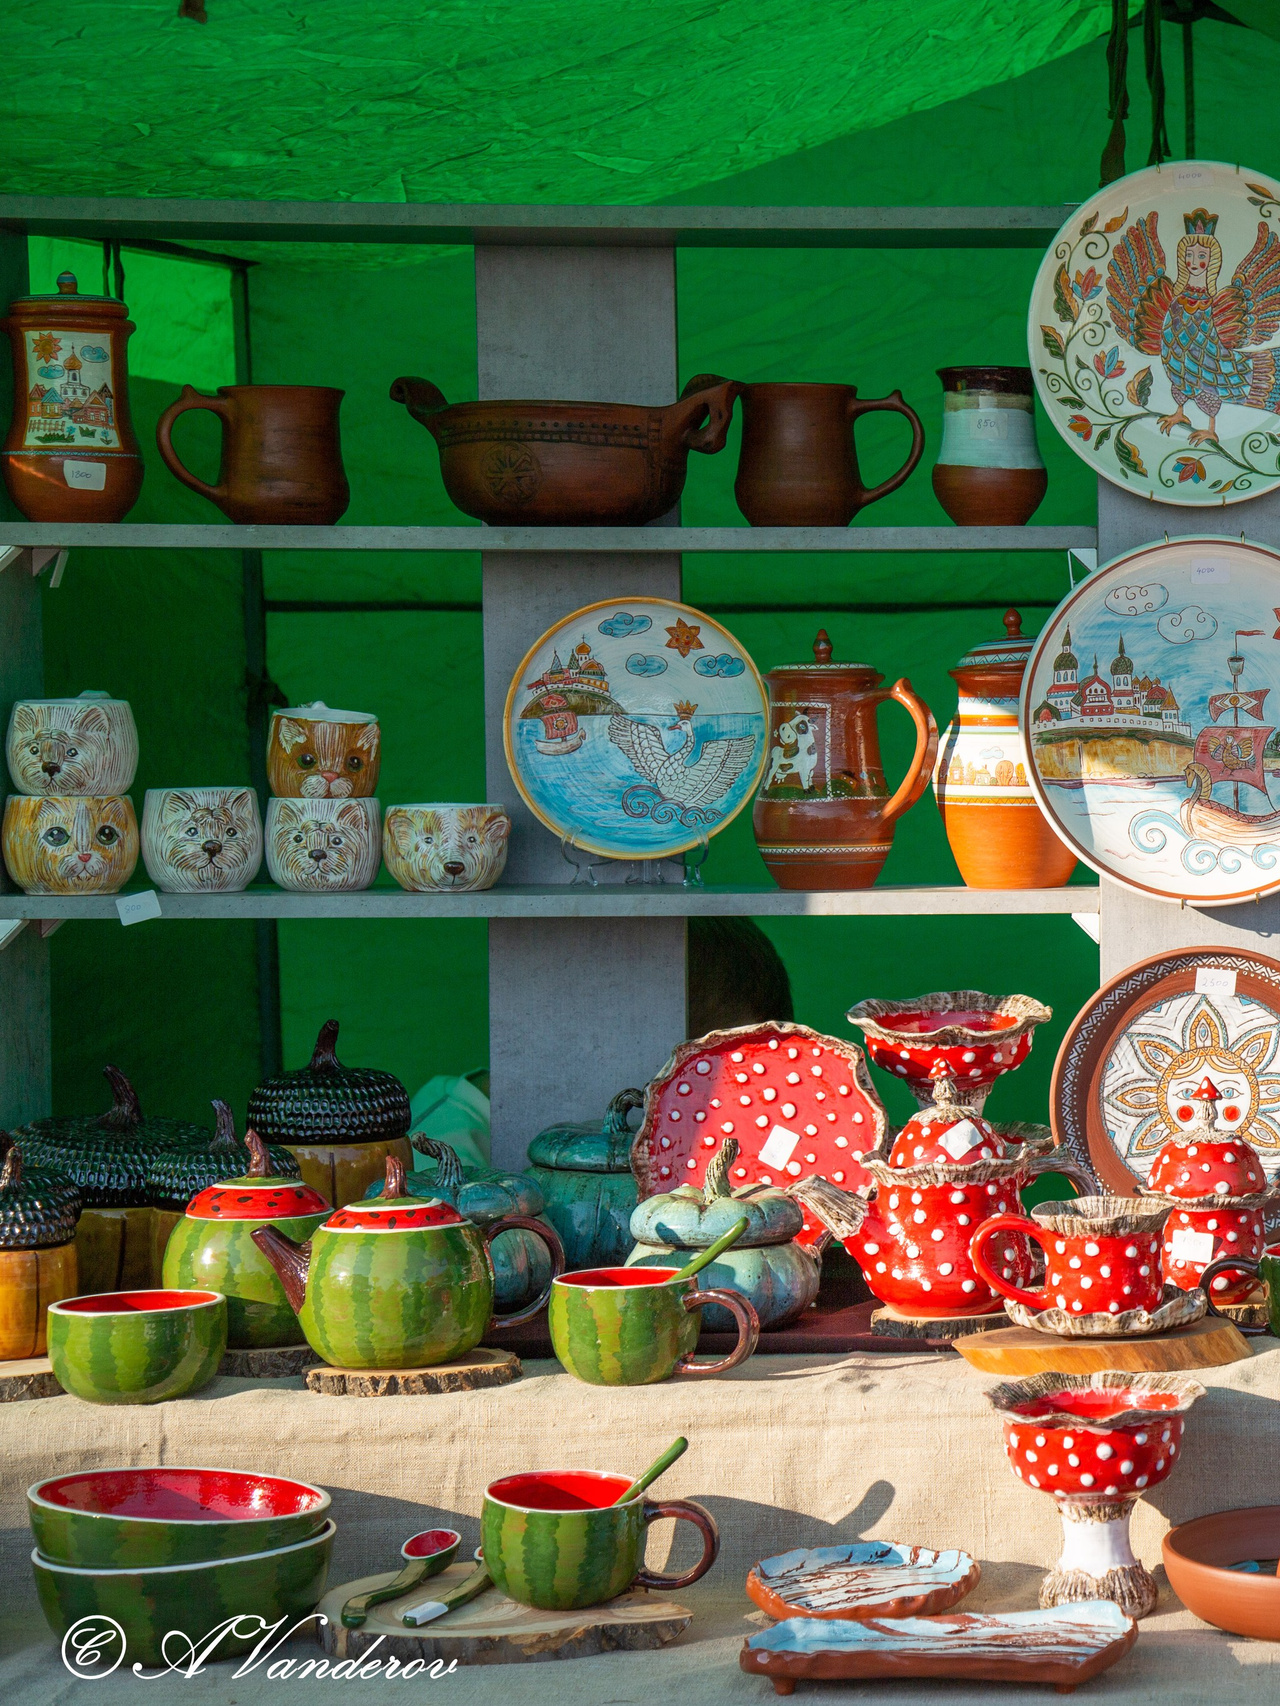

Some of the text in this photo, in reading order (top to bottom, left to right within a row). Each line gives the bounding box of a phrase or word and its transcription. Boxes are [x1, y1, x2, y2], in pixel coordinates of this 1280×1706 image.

[976, 418, 996, 430] 850
[1195, 566, 1216, 576] 4000
[1201, 976, 1230, 988] 2500
